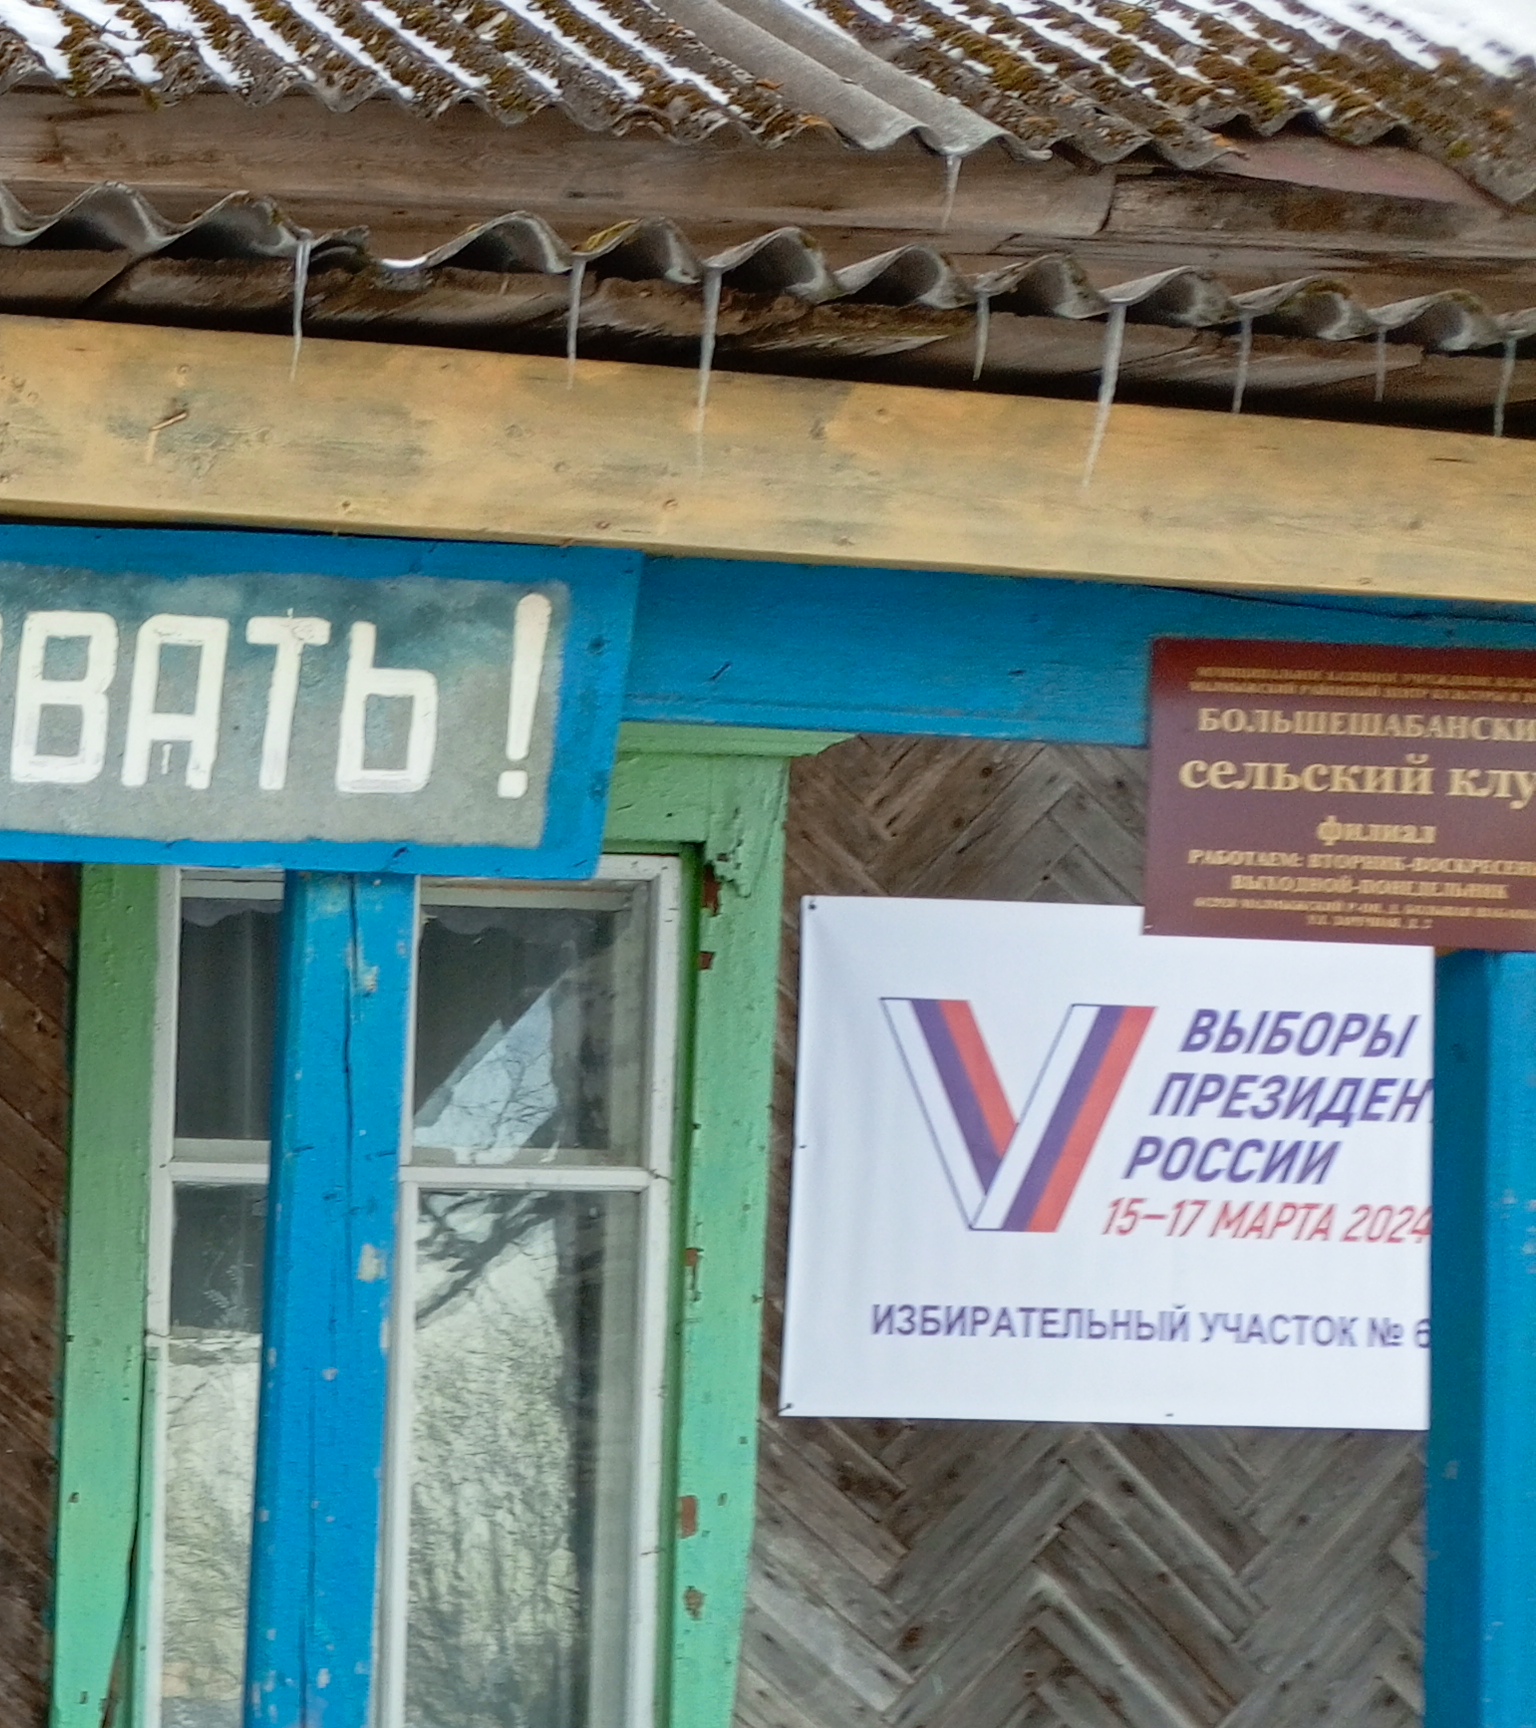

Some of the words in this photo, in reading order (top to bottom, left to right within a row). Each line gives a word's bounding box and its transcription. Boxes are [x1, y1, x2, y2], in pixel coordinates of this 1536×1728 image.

[1178, 752, 1435, 796] сельский
[1180, 1008, 1421, 1058] ВЫБОРЫ
[1149, 1071, 1433, 1128] ПРЕЗИДЕН
[1121, 1135, 1343, 1185] РОССИИ
[1207, 1200, 1338, 1240] МАРТА
[871, 1303, 1191, 1343] ИЗБИРАТЕЛЬНЫЙ
[1199, 1311, 1359, 1347] УЧАСТОК
